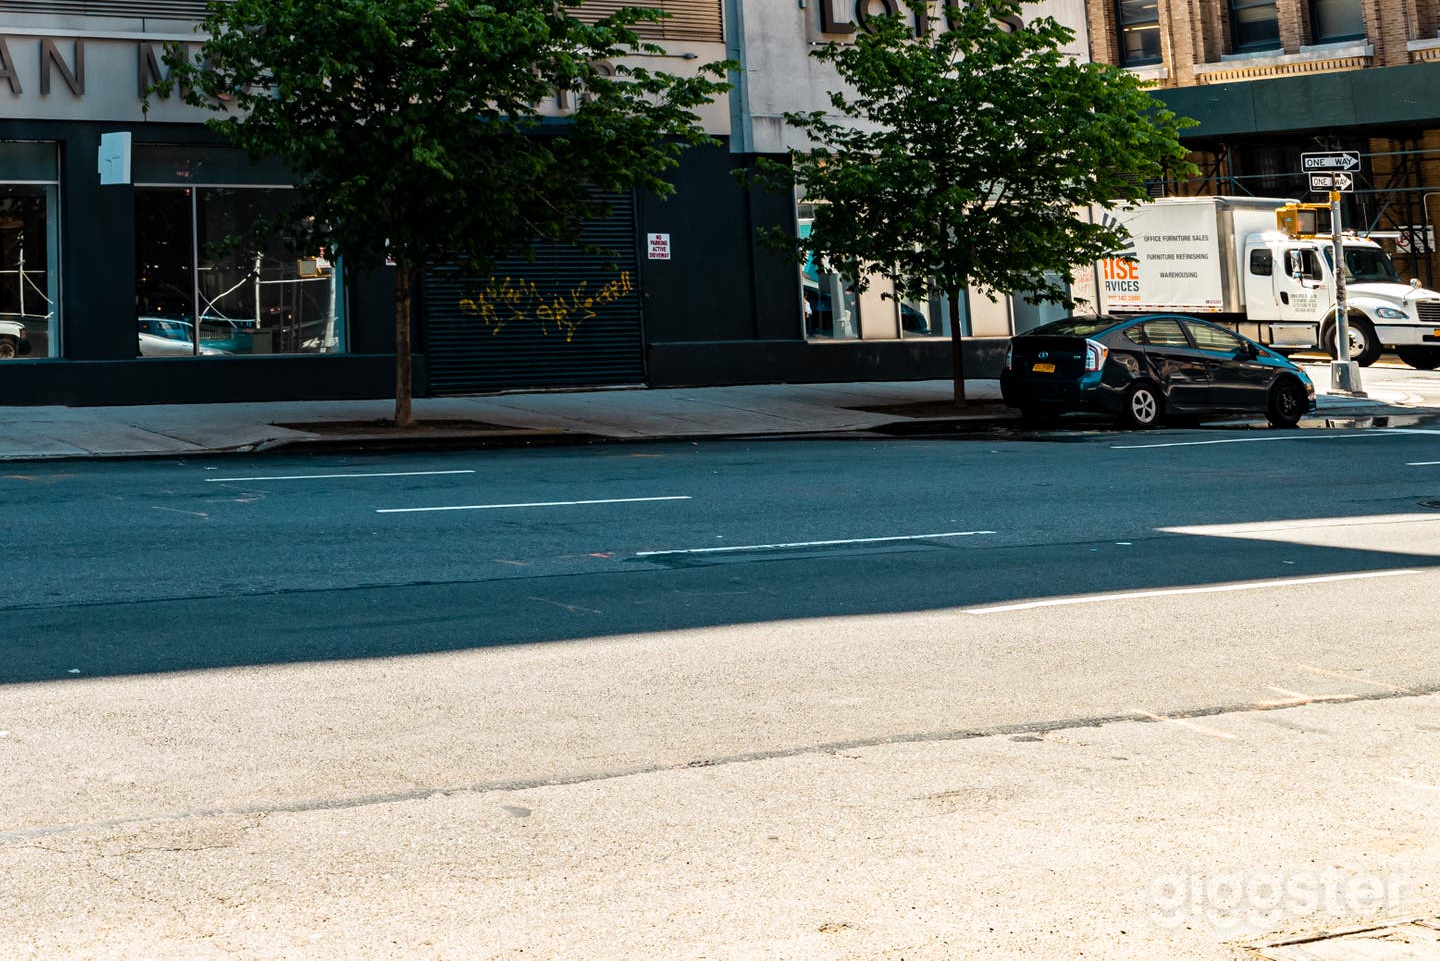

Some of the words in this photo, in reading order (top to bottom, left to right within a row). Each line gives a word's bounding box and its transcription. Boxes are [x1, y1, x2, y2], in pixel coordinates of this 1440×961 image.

[1306, 158, 1326, 167] ONE
[1334, 158, 1352, 166] WAY
[1313, 177, 1328, 186] ONE
[1334, 178, 1348, 186] WAY
[1192, 234, 1209, 242] SALES
[1159, 271, 1198, 279] WAREHOUSING
[1105, 280, 1140, 292] RVICES
